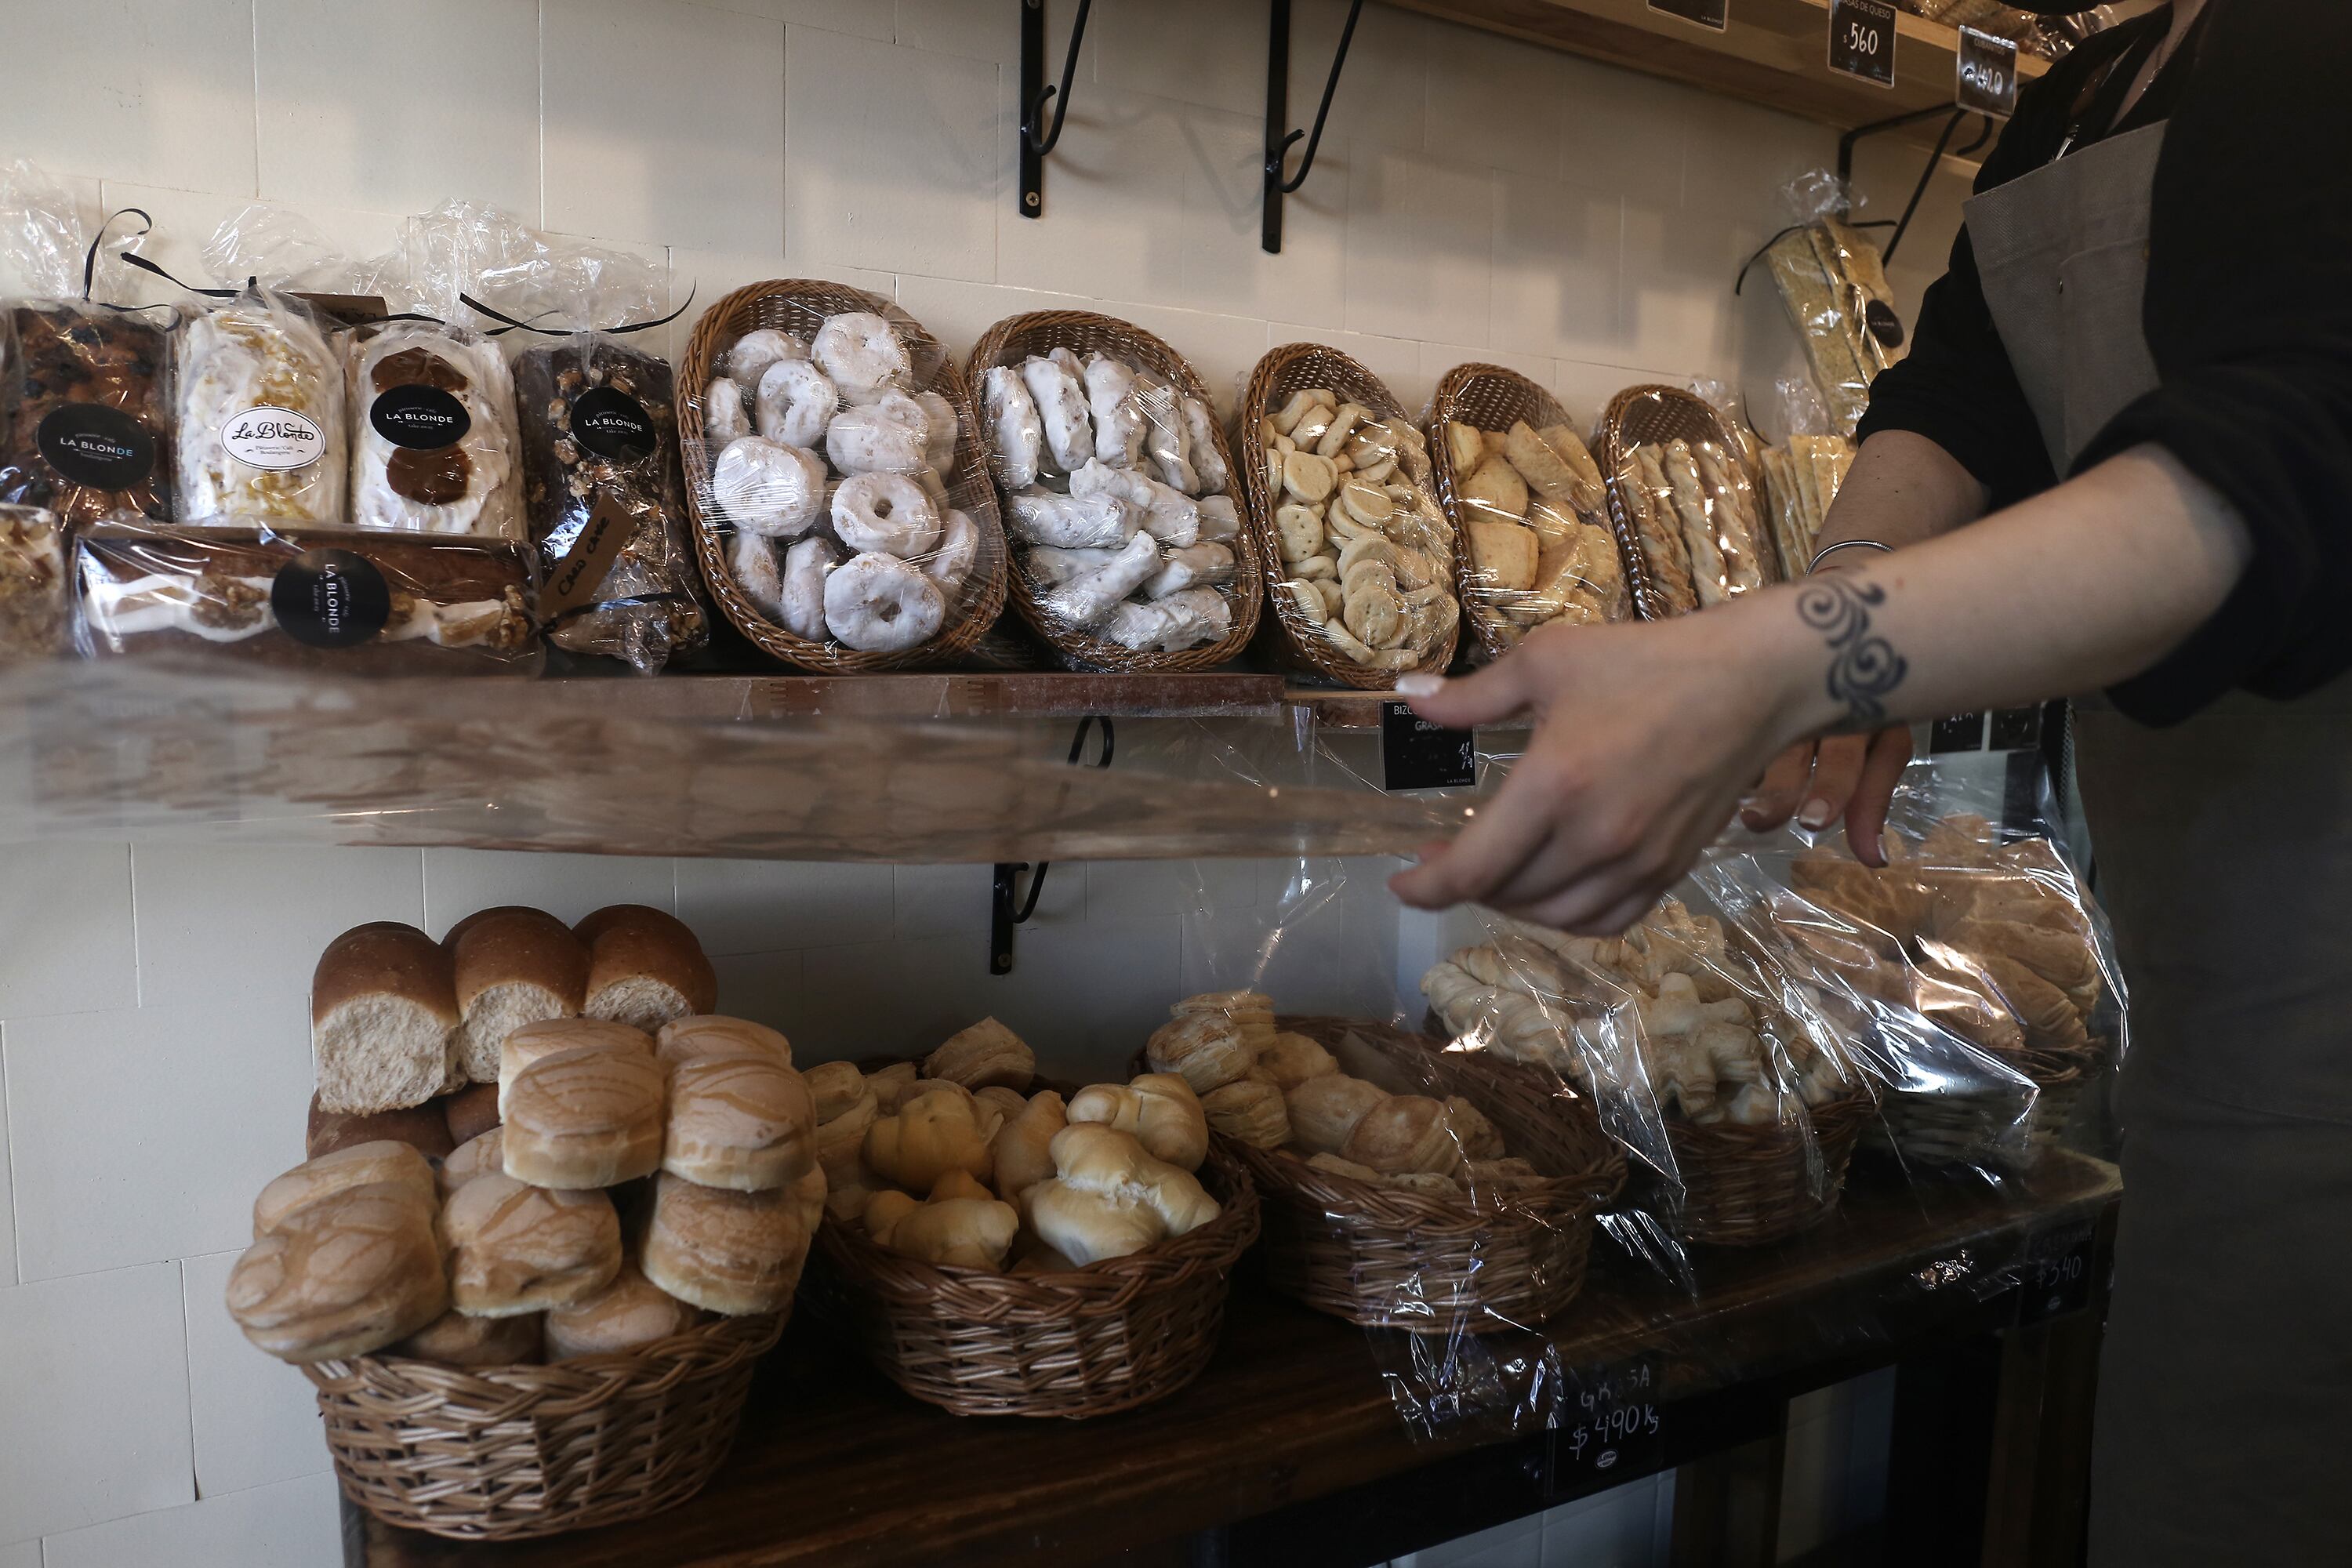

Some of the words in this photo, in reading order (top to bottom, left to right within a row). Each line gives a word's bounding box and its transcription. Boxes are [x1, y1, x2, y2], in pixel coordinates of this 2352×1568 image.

[1860, 2, 1868, 12] DE
[1869, 5, 1890, 19] QUESO
[405, 413, 454, 423] BLONDE
[602, 418, 643, 432] BLONDE
[232, 422, 256, 440] La
[60, 437, 77, 448] LA
[81, 441, 133, 457] BLONDE
[325, 564, 336, 579] LA
[325, 583, 340, 633] BLONDE
